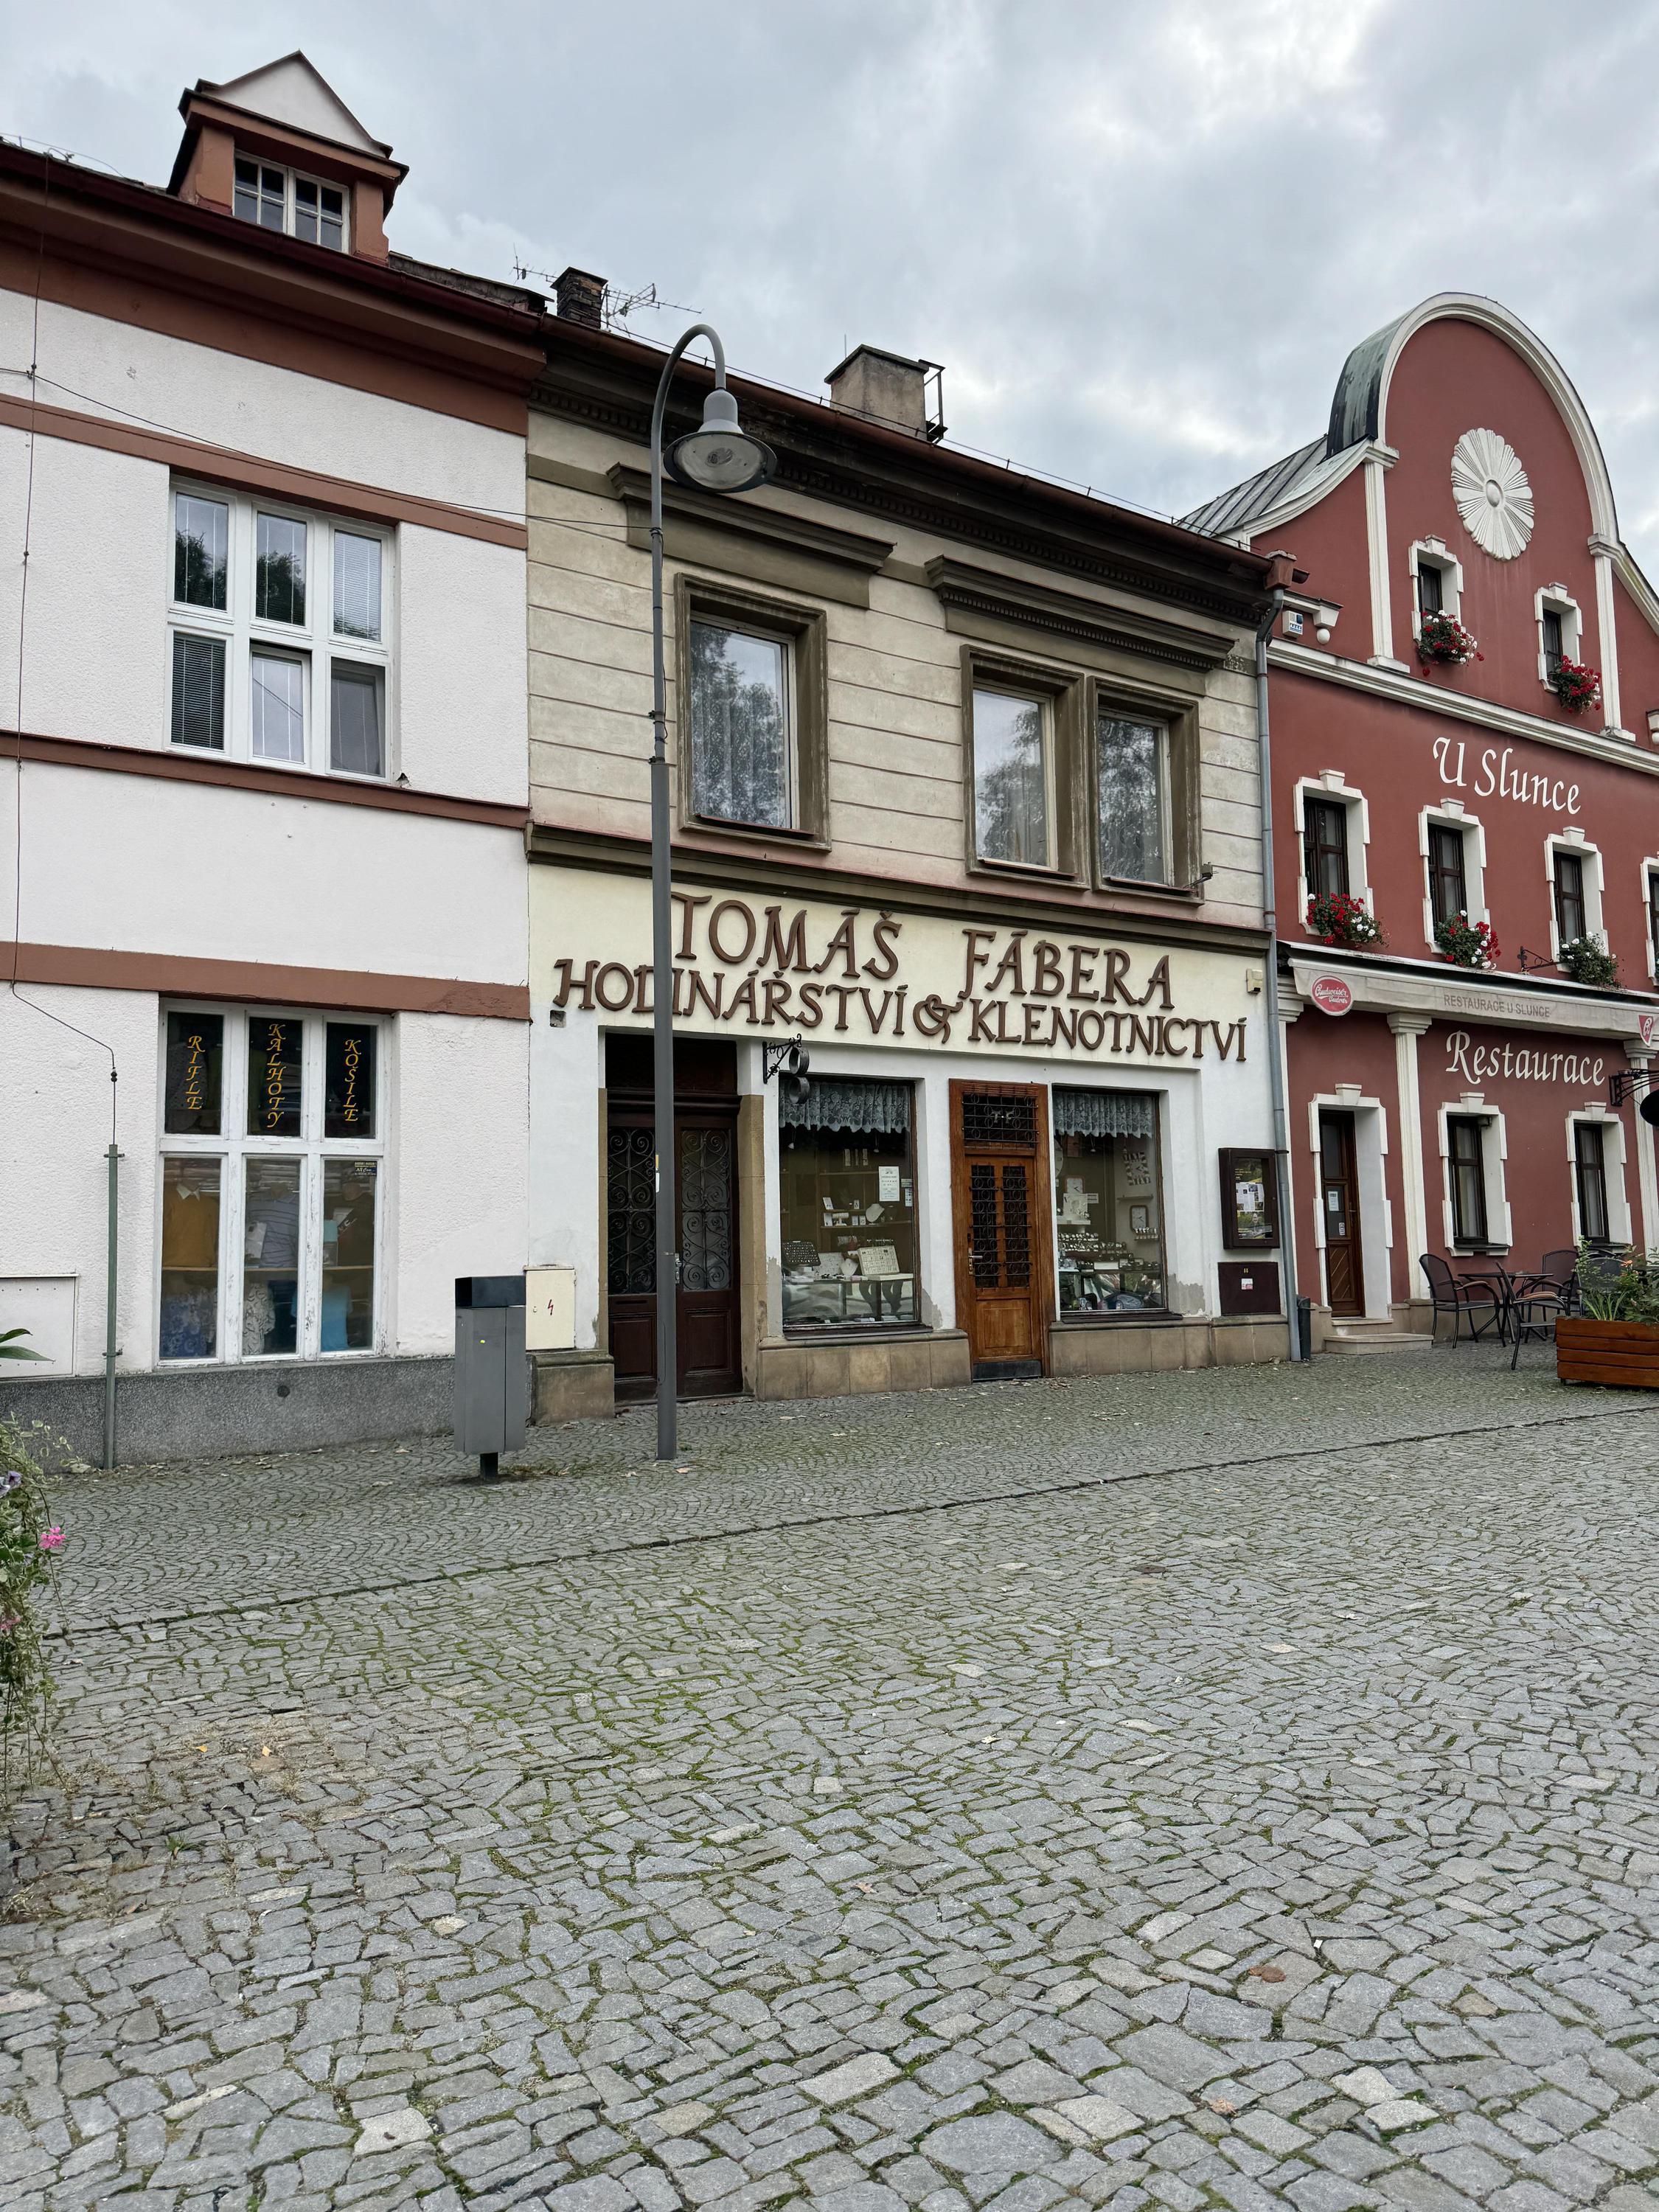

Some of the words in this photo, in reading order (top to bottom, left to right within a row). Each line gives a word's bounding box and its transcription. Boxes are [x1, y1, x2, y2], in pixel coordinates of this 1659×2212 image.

[1433, 737, 1467, 787] U
[1474, 748, 1582, 815] Slunce
[671, 891, 902, 980] TOMÁŠ
[958, 928, 1175, 1009] FÁBERA
[913, 994, 964, 1044] &
[967, 998, 1248, 1062] KLENOTNICTVÍ
[1444, 995, 1505, 1012] RESTAURACE
[1507, 1003, 1513, 1014] U
[1515, 1004, 1550, 1018] SLUNCE
[186, 1035, 206, 1110] RIFLE
[266, 1023, 286, 1128] KALHOTY
[343, 1039, 362, 1121] KOŠILE
[1445, 1030, 1605, 1086] Restaurace
